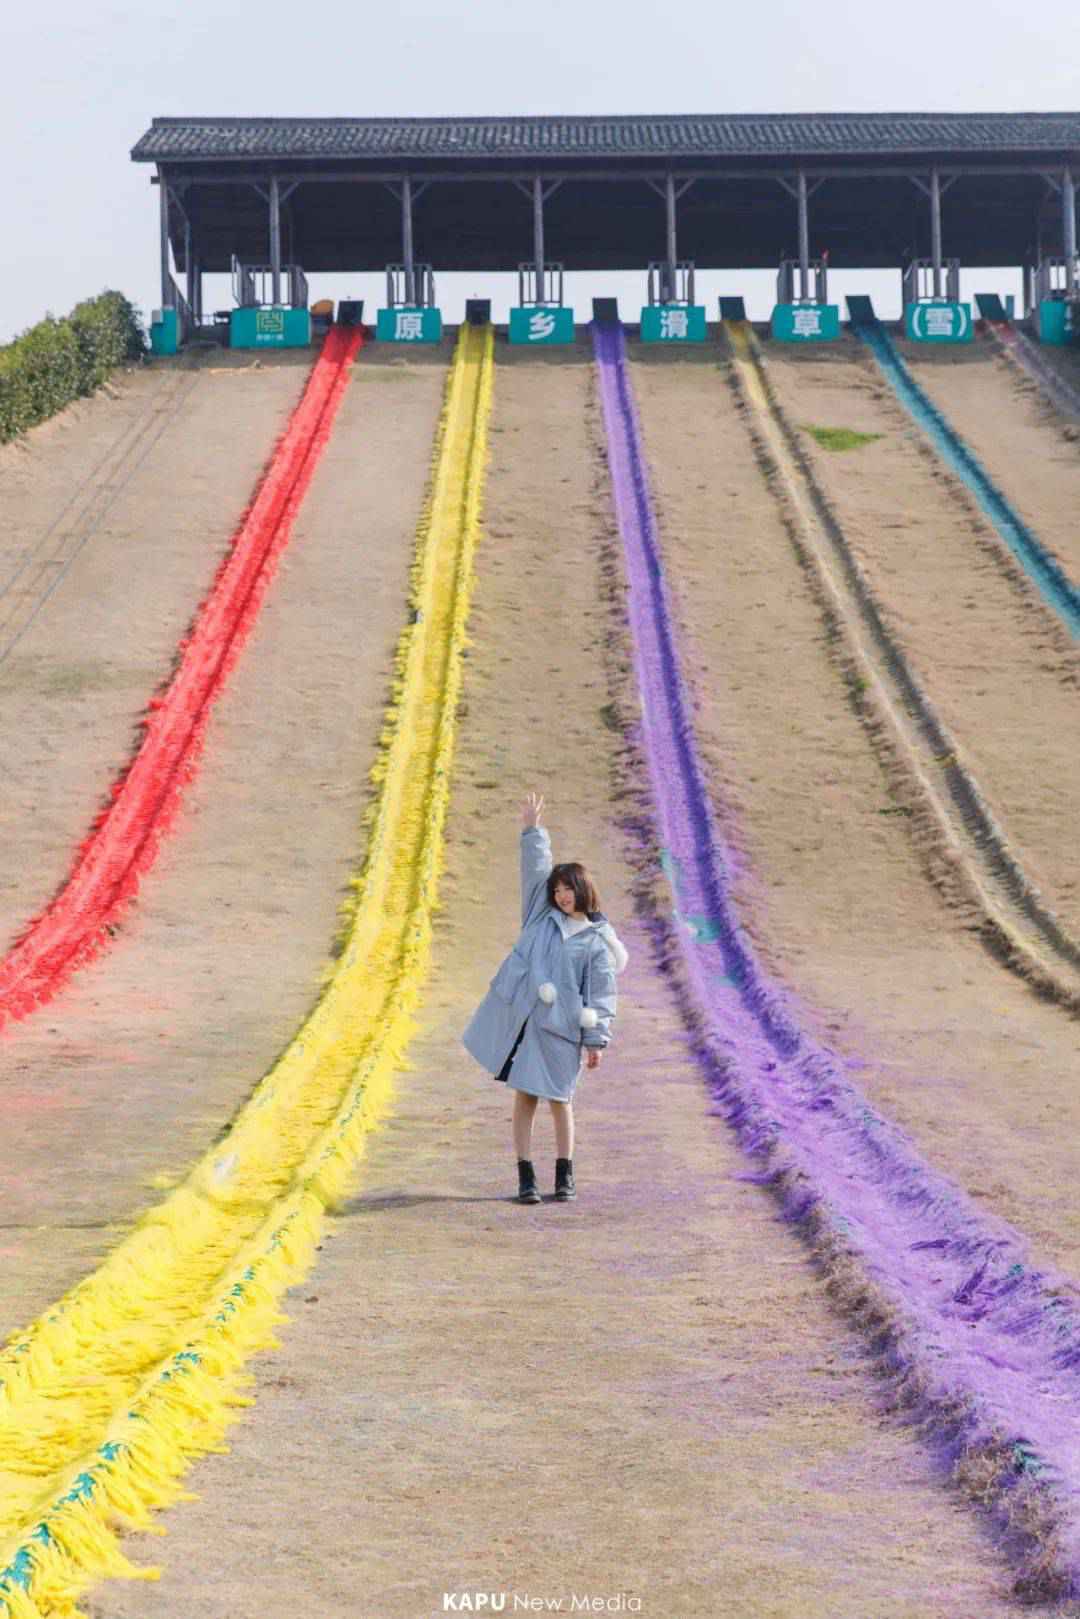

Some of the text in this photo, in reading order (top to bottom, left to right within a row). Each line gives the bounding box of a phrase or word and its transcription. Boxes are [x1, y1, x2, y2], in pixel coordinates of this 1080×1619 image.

[394, 312, 424, 340] 原
[527, 311, 556, 340] 乡
[660, 310, 689, 338] 滑
[792, 309, 821, 337] 草
